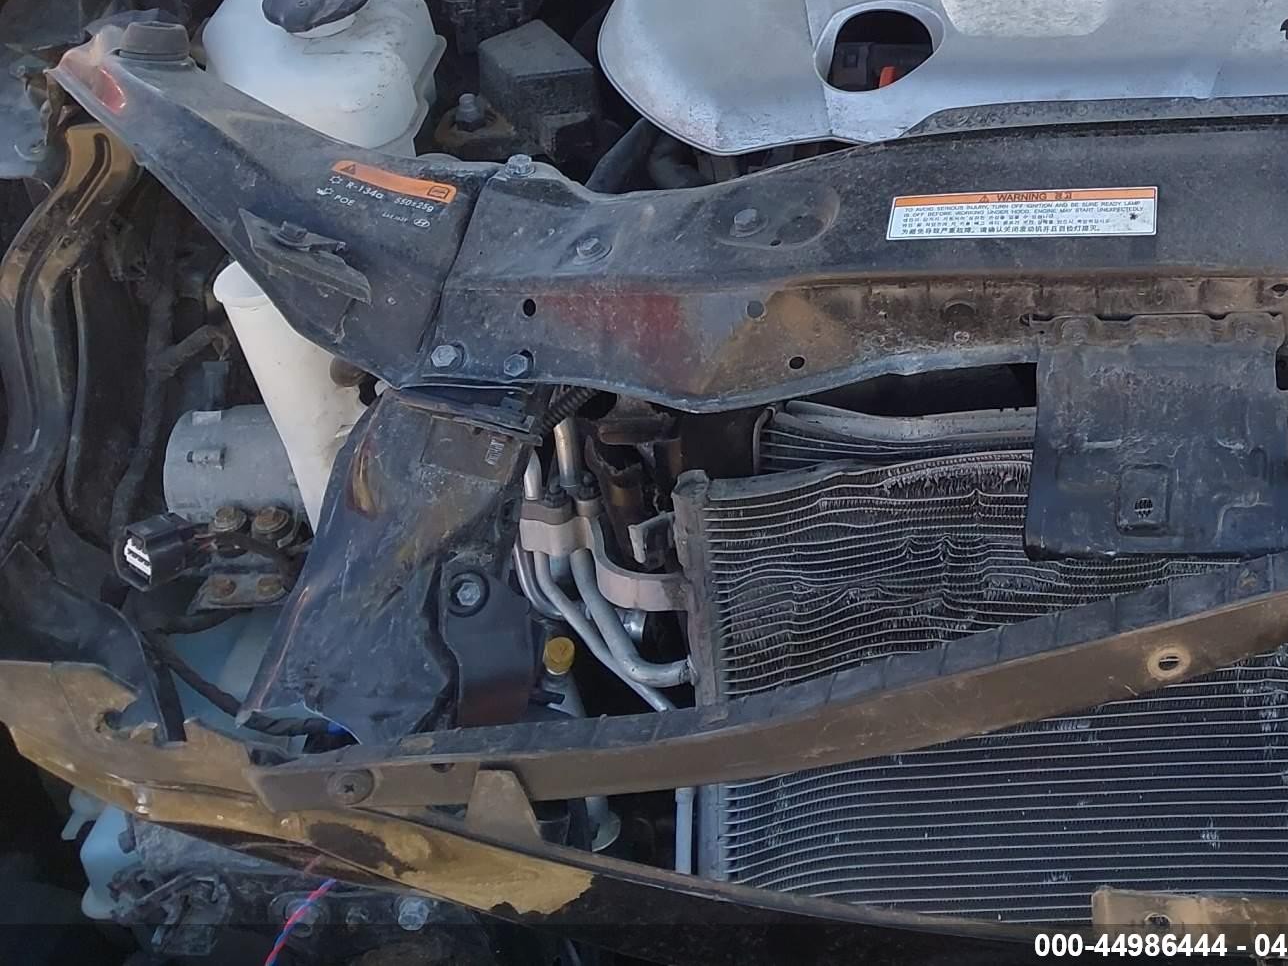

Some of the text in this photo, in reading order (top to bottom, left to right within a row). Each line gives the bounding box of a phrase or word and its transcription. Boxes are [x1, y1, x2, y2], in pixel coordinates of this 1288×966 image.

[345, 181, 385, 199] R-134a
[995, 192, 1047, 201] WARNING
[333, 194, 356, 207] POE
